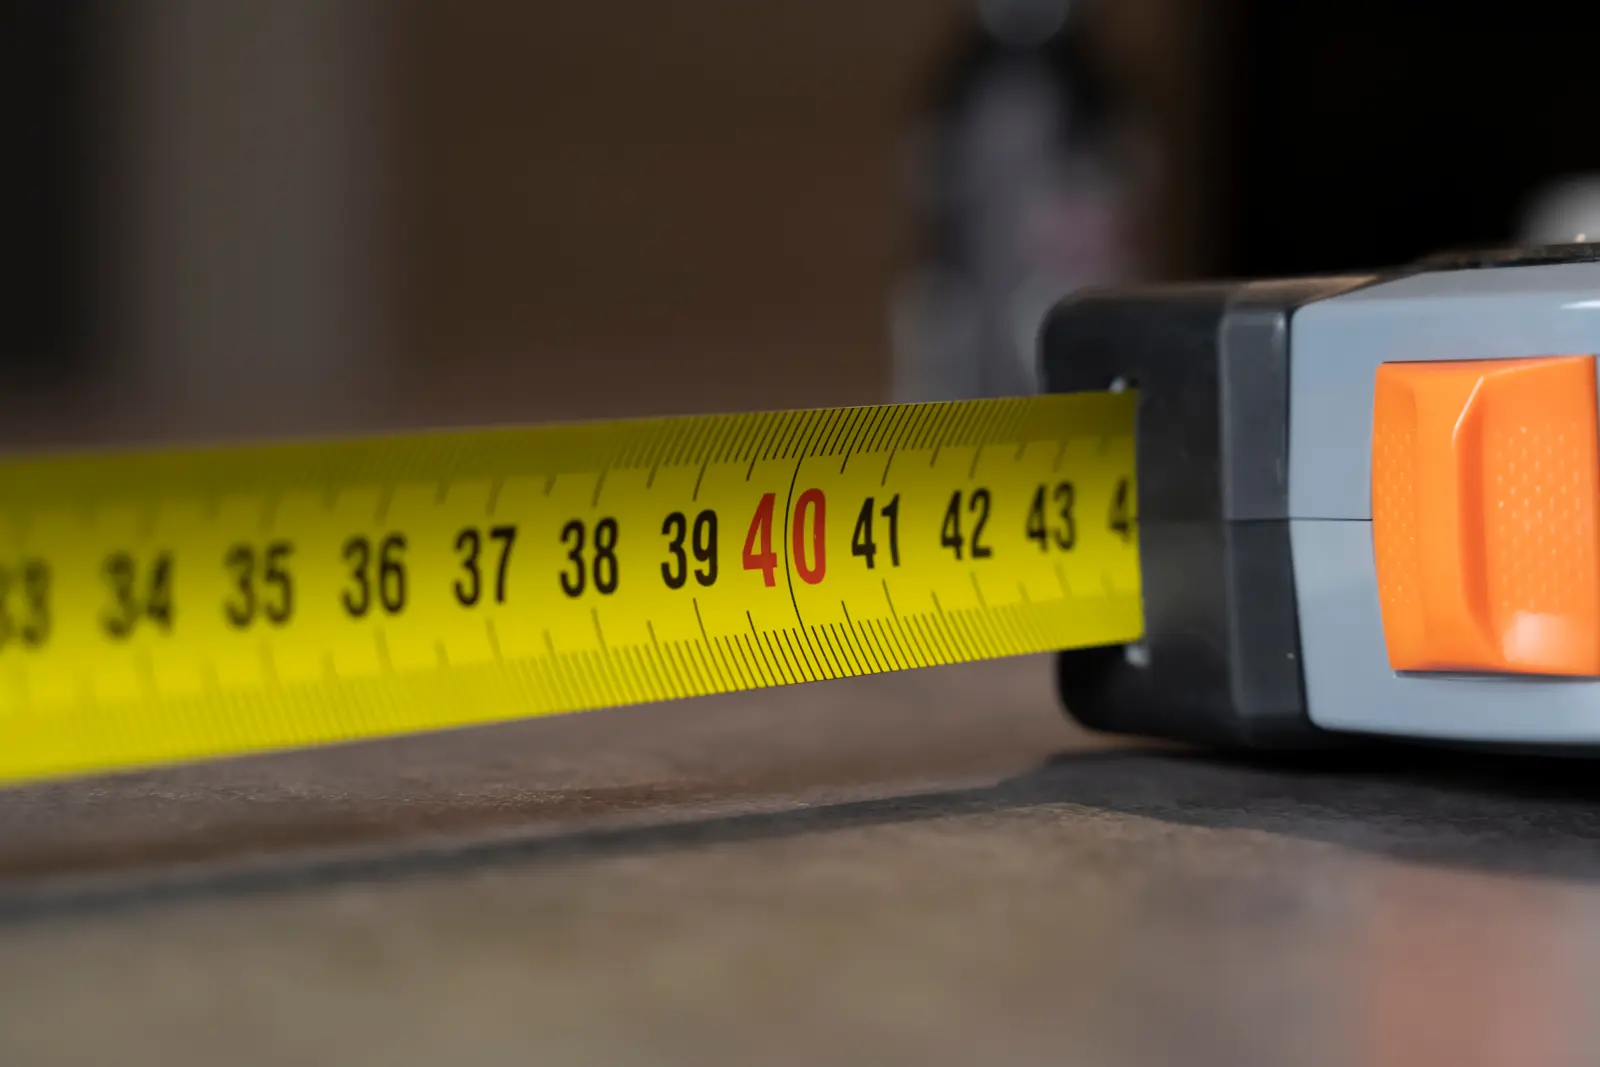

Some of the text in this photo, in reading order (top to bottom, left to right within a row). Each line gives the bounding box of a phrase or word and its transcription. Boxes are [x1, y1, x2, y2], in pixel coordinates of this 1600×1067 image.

[101, 548, 176, 642] 34
[224, 541, 297, 630] 35
[339, 531, 408, 619] 36
[453, 525, 517, 608] 37
[559, 516, 620, 598] 38
[661, 509, 719, 590] 39
[742, 487, 827, 586] 40
[852, 493, 901, 570] 41
[941, 488, 994, 561] 42
[1025, 480, 1077, 553] 43
[1106, 475, 1138, 546] 4
